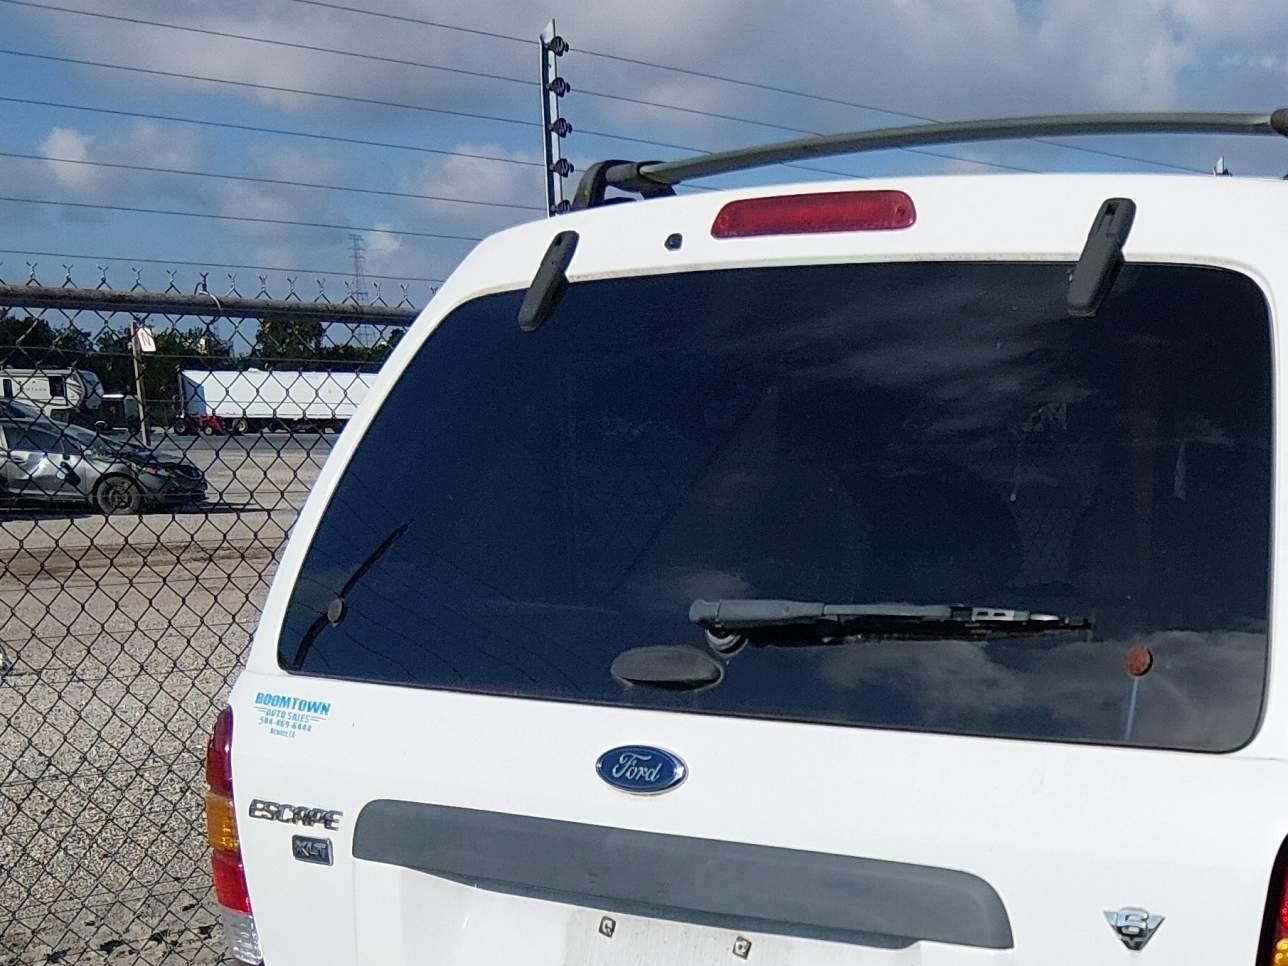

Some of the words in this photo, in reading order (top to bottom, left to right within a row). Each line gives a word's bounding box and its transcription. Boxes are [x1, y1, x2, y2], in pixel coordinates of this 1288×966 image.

[255, 692, 331, 715] BOOMTOWN
[265, 708, 286, 718] AUTO
[288, 711, 310, 723] SALES
[612, 752, 662, 782] Ford
[248, 798, 343, 831] ESCAPE
[295, 840, 326, 859] XLT
